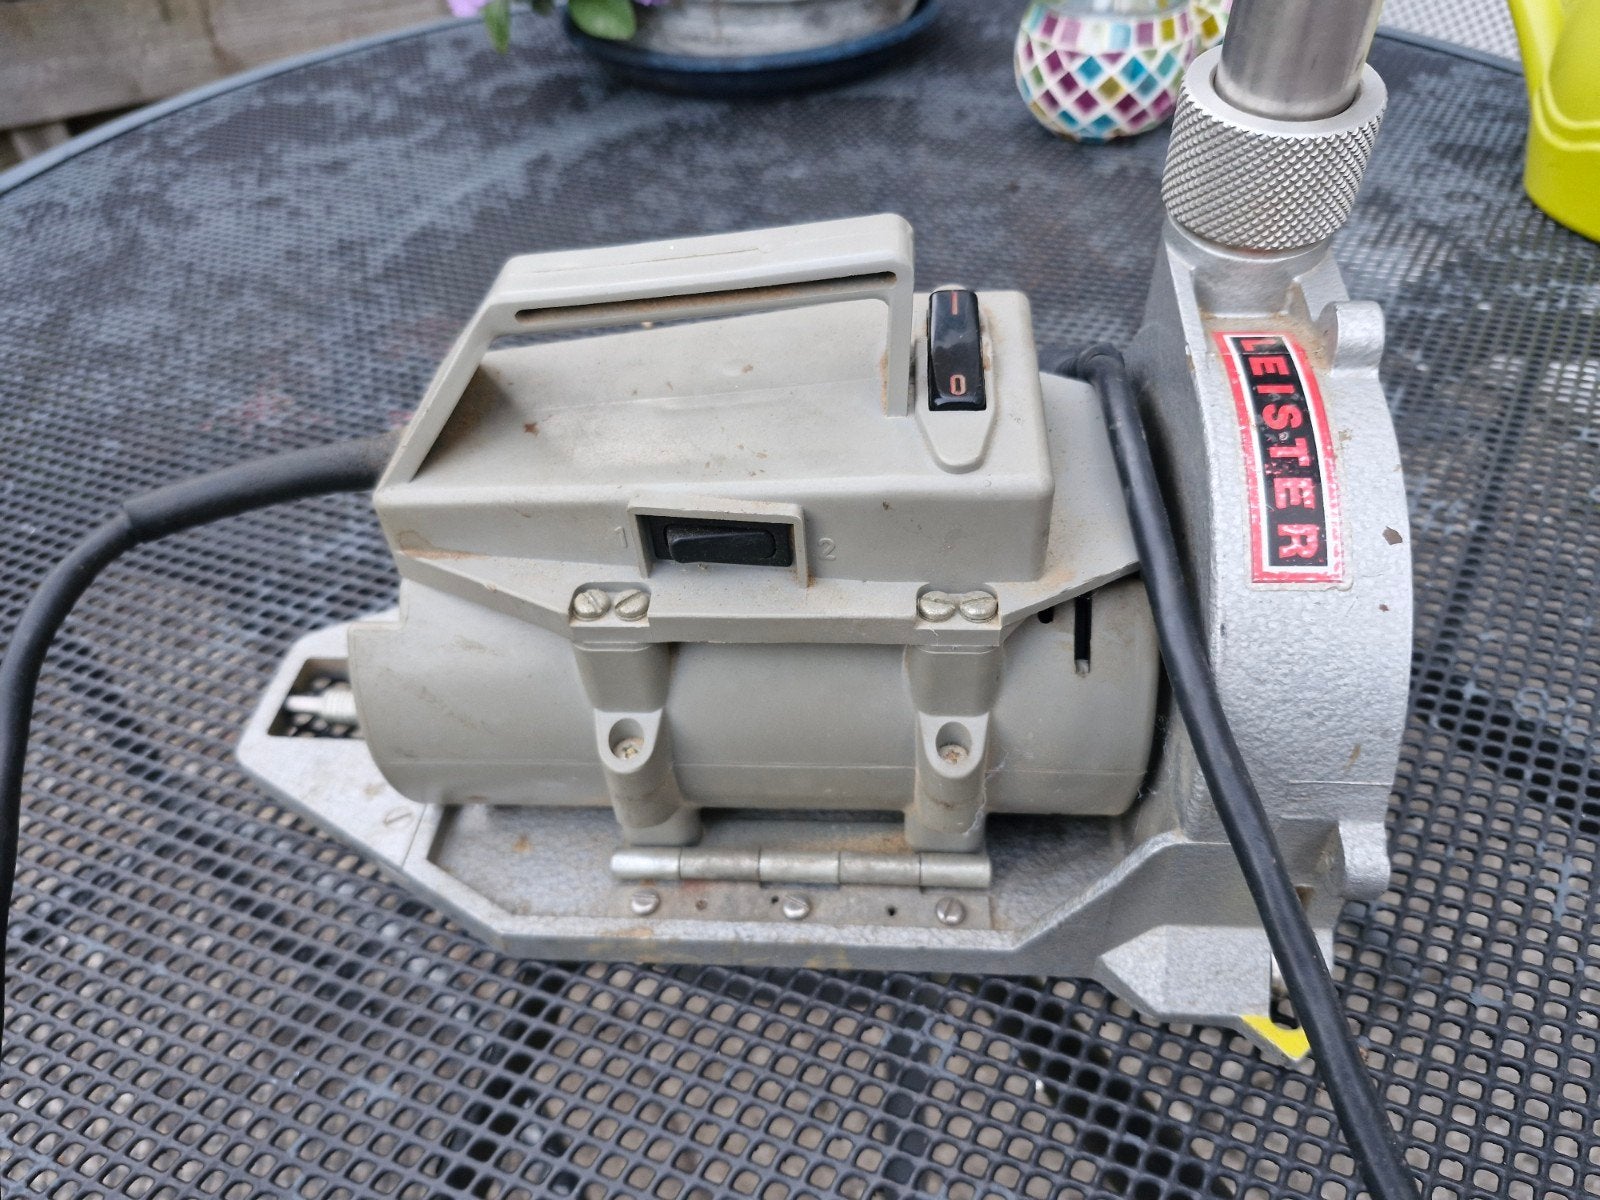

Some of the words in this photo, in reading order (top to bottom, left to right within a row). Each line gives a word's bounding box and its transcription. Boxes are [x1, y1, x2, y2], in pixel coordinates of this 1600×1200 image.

[1242, 338, 1320, 560] LEISTER
[614, 526, 628, 549] 1
[817, 537, 836, 561] 2
